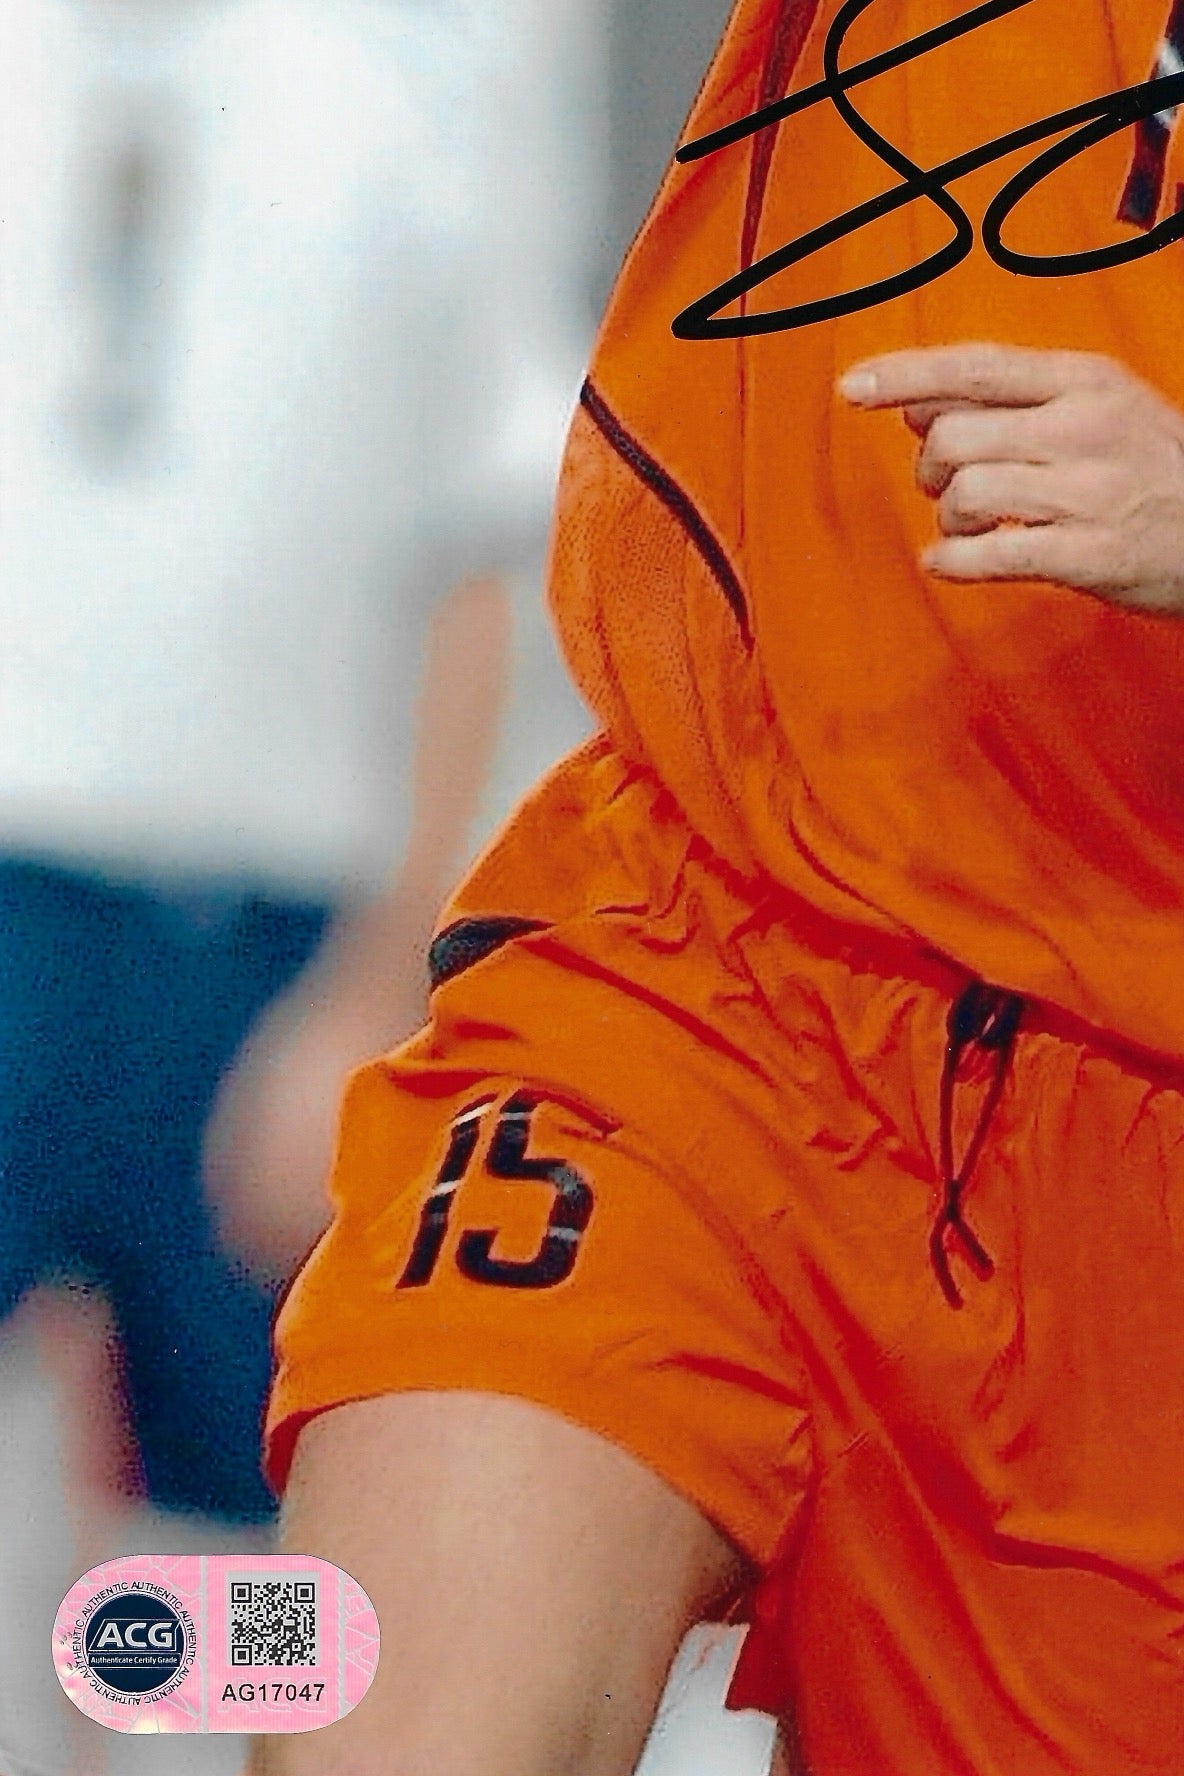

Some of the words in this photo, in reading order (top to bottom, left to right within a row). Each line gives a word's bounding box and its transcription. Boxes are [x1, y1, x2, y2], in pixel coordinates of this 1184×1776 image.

[395, 1088, 620, 1288] 15
[82, 1582, 128, 1617] AUTHENTIC
[131, 1581, 183, 1609] AUTHENTIC
[72, 1619, 92, 1679] AUTHENTIC
[97, 1622, 173, 1648] ACG
[180, 1610, 197, 1665] AUTHENTIC
[90, 1656, 133, 1664] Authenticate
[134, 1656, 156, 1665] Certify
[157, 1656, 178, 1664] Grade
[89, 1679, 140, 1705] AUTHENTIC
[144, 1666, 190, 1704] AUTHENTIC
[221, 1683, 326, 1702] AG17047
